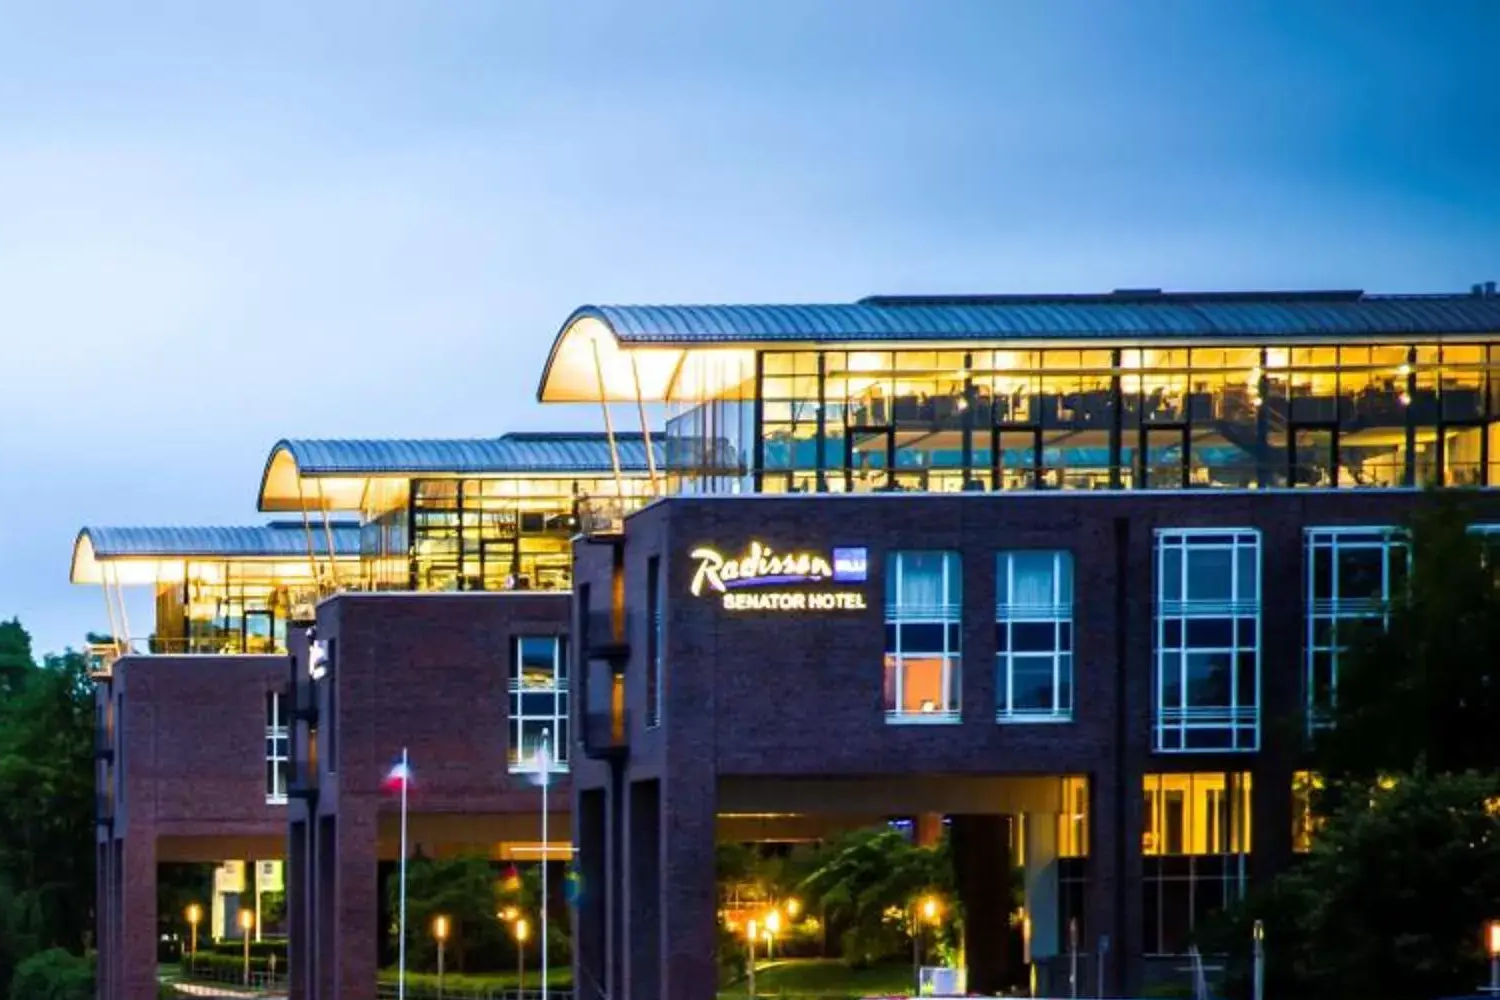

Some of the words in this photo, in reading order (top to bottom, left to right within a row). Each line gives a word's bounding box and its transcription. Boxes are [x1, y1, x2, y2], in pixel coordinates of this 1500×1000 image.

[690, 541, 832, 597] Radisson
[723, 592, 804, 609] SENATOR
[807, 592, 867, 609] HOTEL
